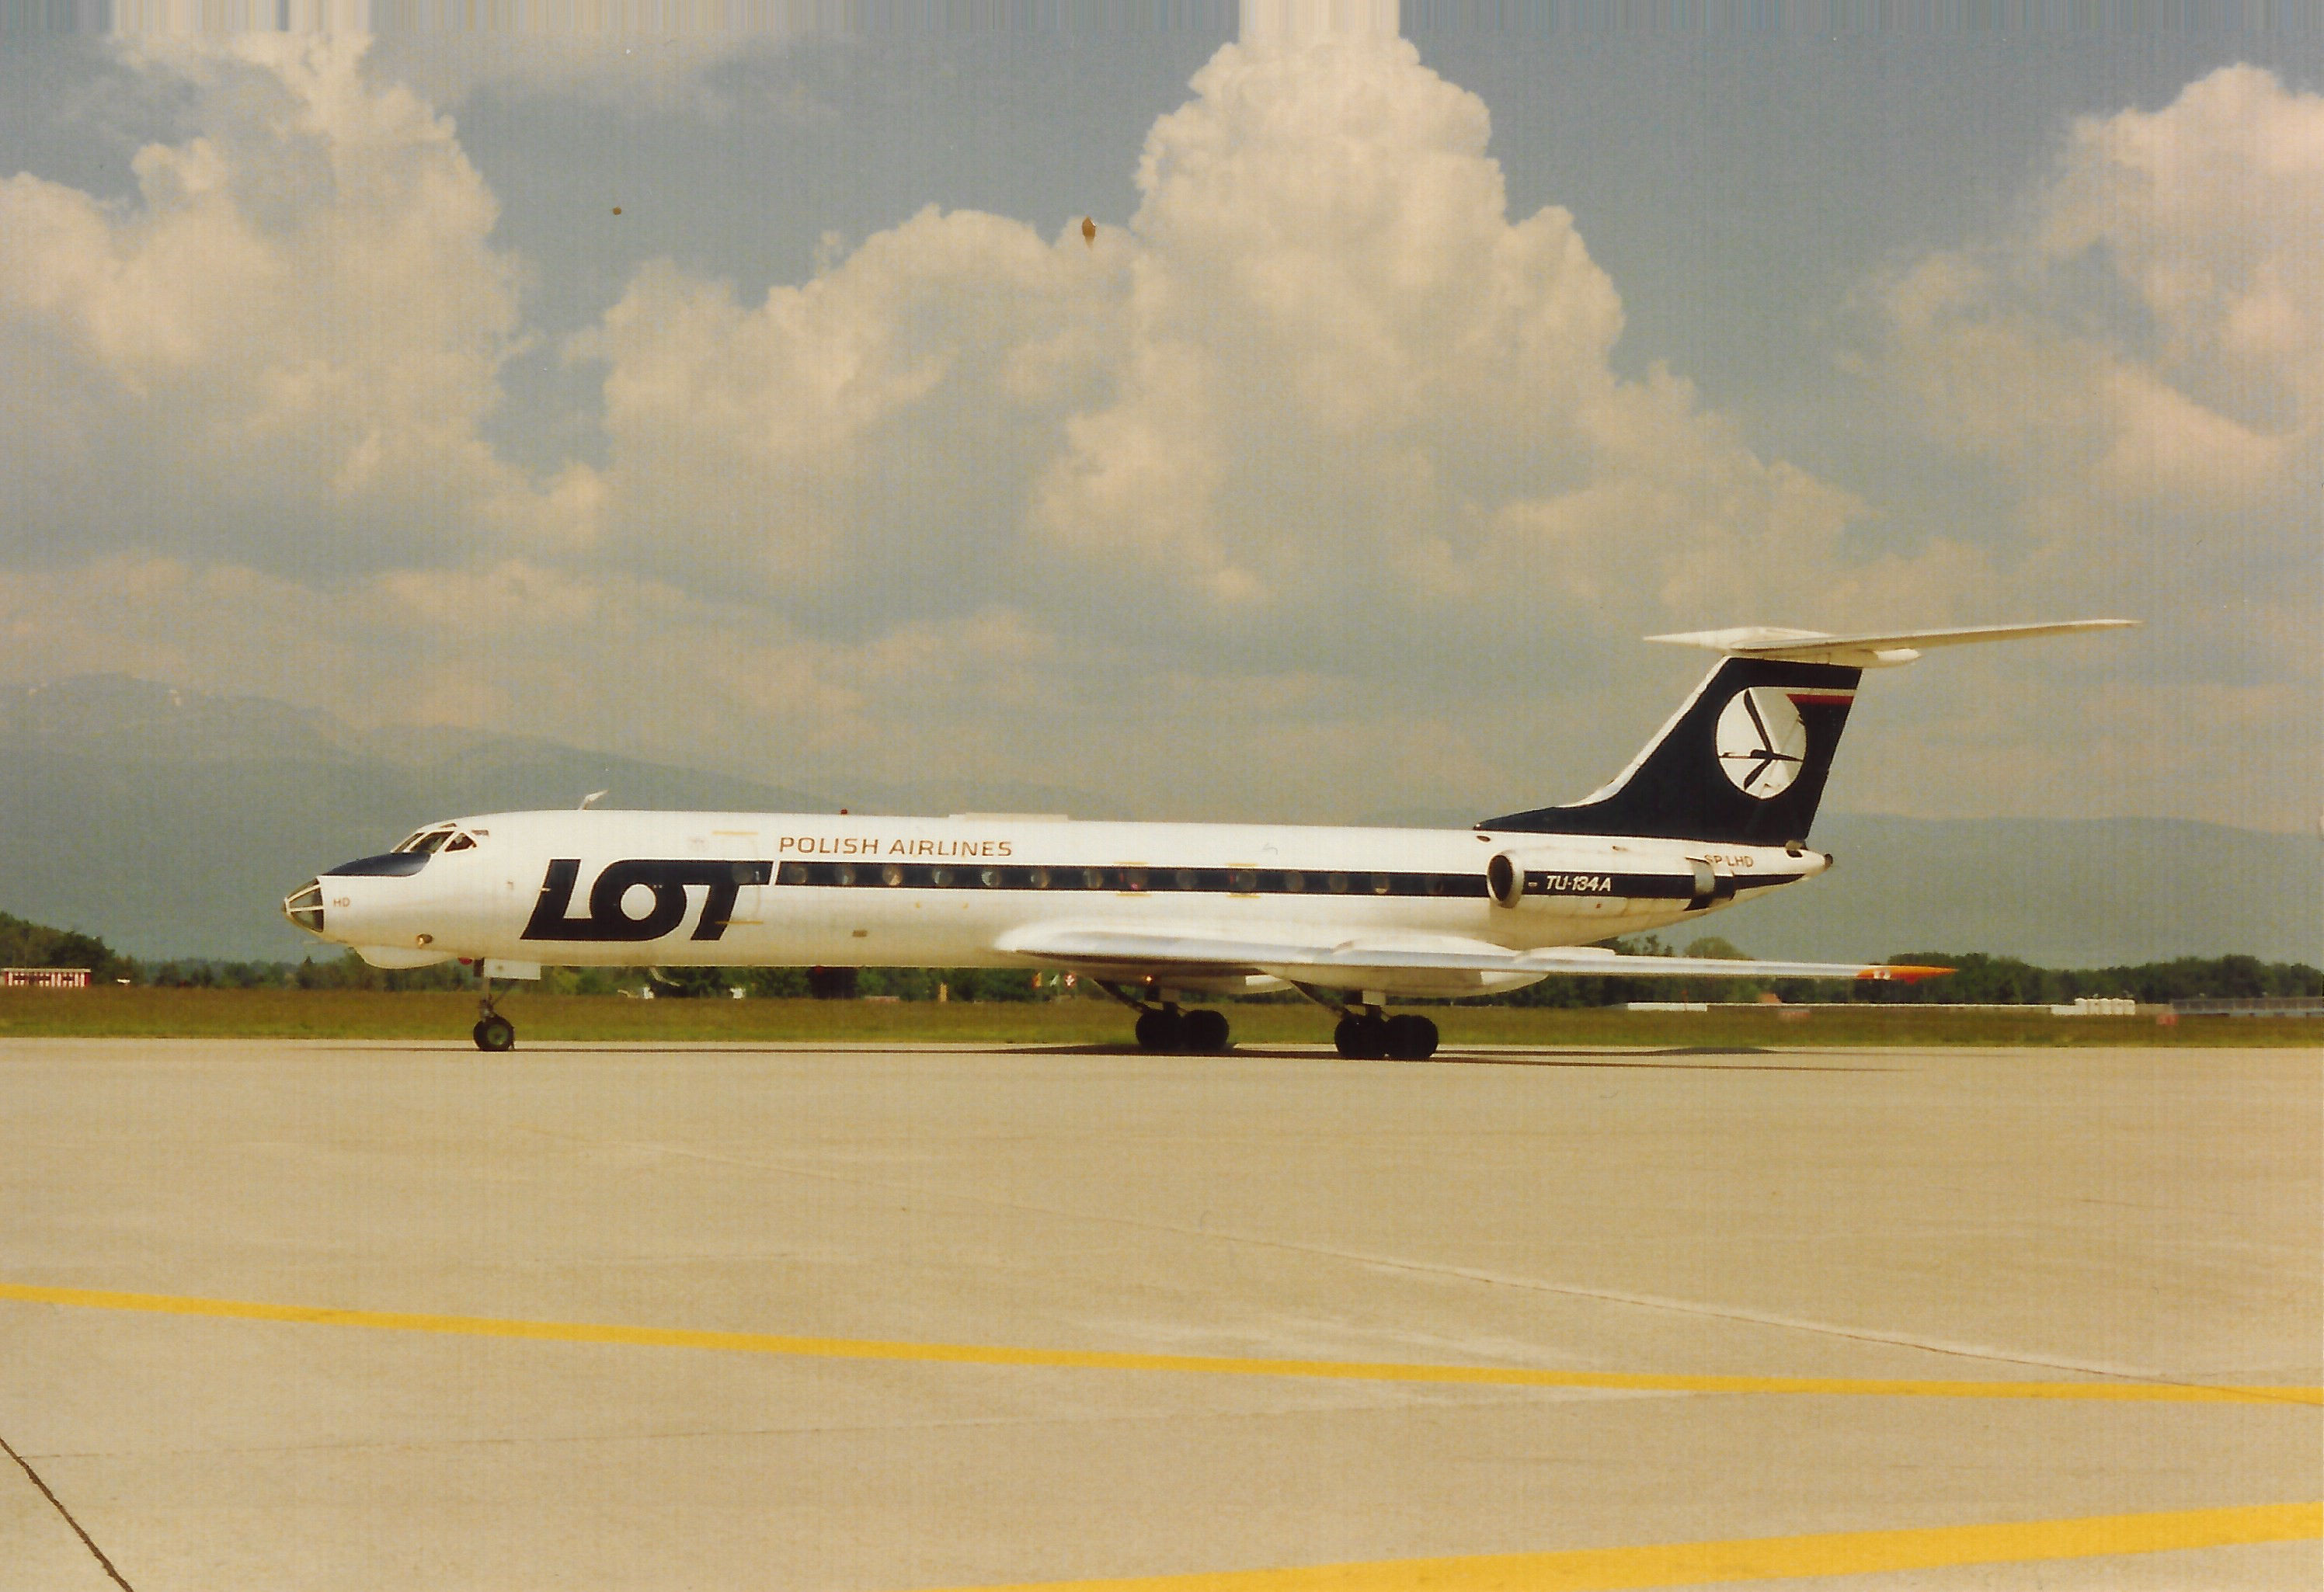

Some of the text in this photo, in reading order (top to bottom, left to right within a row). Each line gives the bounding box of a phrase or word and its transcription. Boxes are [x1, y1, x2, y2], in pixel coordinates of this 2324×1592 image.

[779, 836, 1012, 857] POLISH AIRLINES
[1546, 875, 1611, 892] TU-134A
[332, 896, 351, 908] HD
[520, 858, 774, 941] LOT
